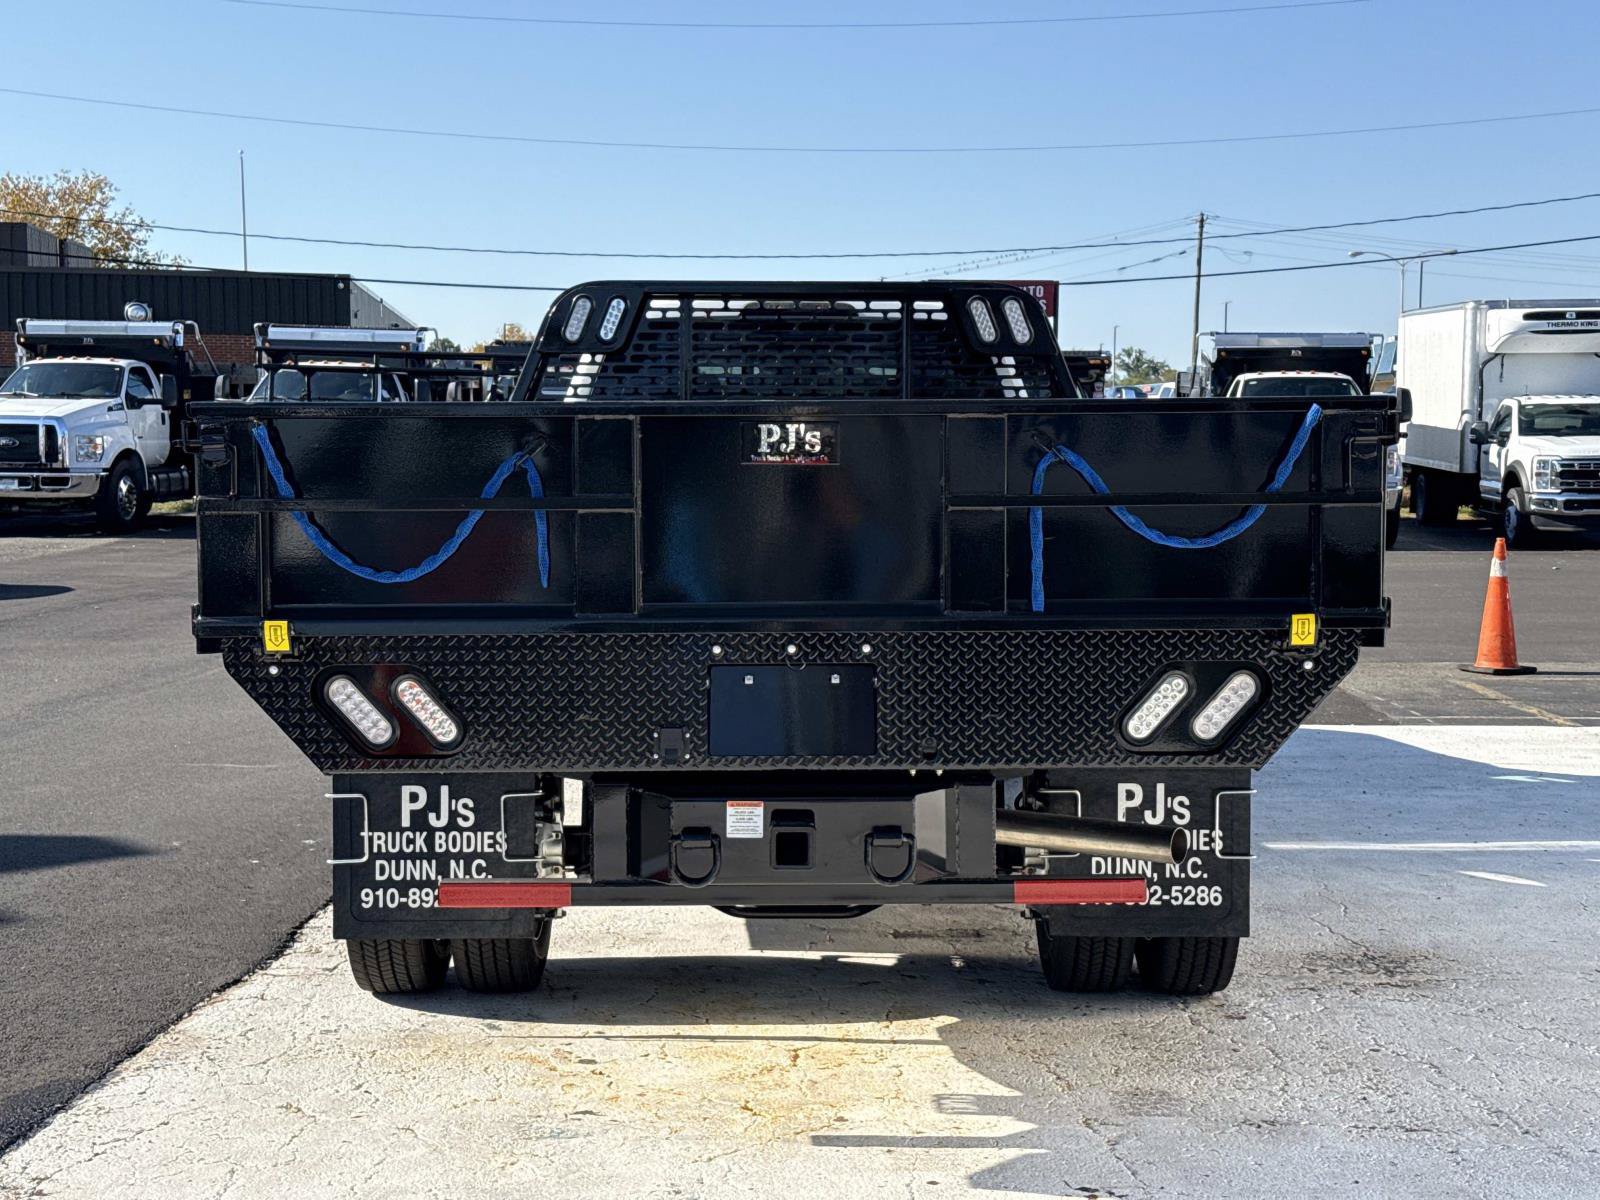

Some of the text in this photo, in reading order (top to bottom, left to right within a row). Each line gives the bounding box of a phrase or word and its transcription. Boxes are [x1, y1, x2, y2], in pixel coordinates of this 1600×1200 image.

[757, 423, 821, 453] PJ's
[434, 831, 508, 853] BODIES
[375, 859, 493, 883] DUNN, N.C.
[1165, 857, 1208, 879] N.C.
